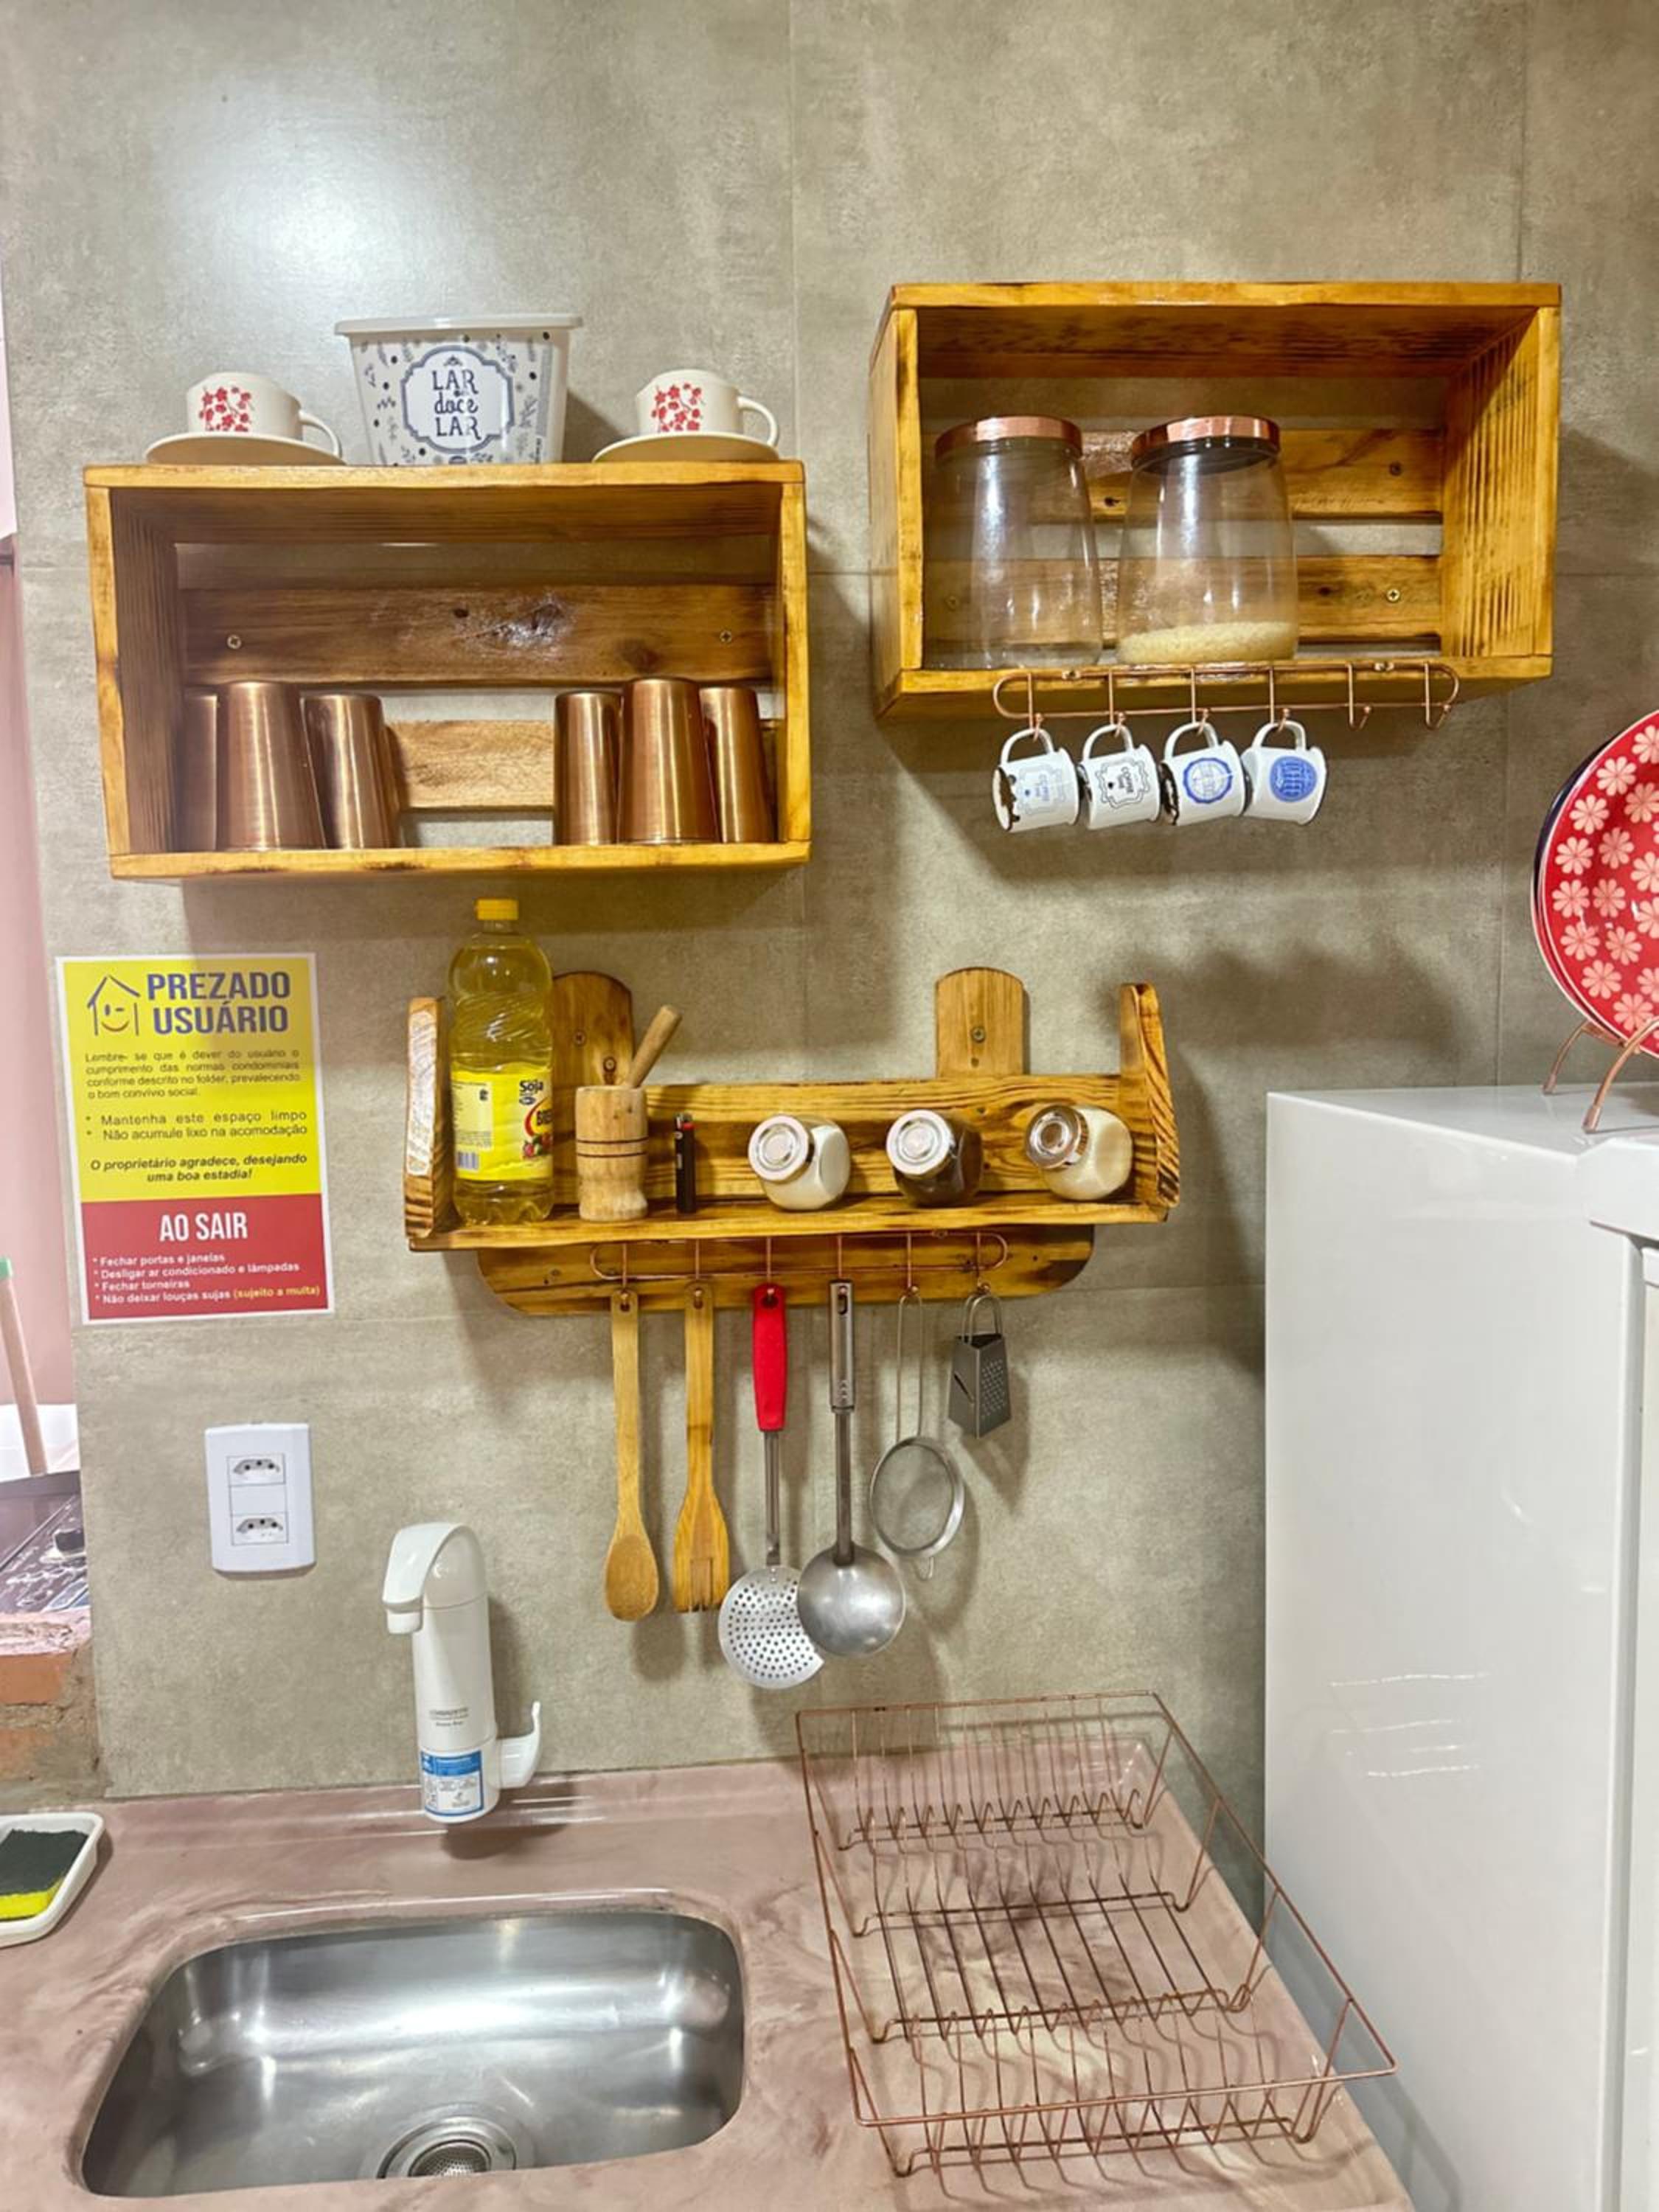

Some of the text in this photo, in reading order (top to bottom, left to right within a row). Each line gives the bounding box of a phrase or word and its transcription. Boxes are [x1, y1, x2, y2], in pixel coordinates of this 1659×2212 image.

[431, 369, 479, 394] LAR
[434, 392, 479, 414] doce
[435, 416, 481, 440] LAR
[147, 971, 291, 1001] PREZADO
[152, 1002, 288, 1034] USUÁRIO
[153, 1051, 174, 1062] que
[192, 1050, 222, 1060] dever
[227, 1049, 241, 1058] do
[86, 1062, 299, 1075] cumprimento das normas condominiais
[87, 1077, 136, 1087] conforme
[137, 1076, 179, 1086] descrito
[181, 1076, 195, 1085] no
[231, 1074, 300, 1084] prevalecendo
[97, 1089, 121, 1099] bom
[101, 1110, 307, 1125] Mantenha este espaço limpo
[102, 1124, 307, 1140] Não acumule lixo na acomodação
[91, 1153, 307, 1172] O proprietário agradece, desejando
[147, 1169, 253, 1183] uma boa estadia!
[159, 1211, 248, 1242] AO SAIR
[100, 1256, 137, 1266] Fechar
[140, 1255, 175, 1267] portas
[186, 1253, 225, 1265] janelas
[101, 1269, 146, 1280] Desligar
[161, 1265, 236, 1276] condicionado
[237, 1265, 246, 1273] e
[247, 1262, 300, 1273] lâmpadas
[102, 1280, 190, 1291] Fechar torneiras
[102, 1294, 125, 1304] Não
[127, 1294, 160, 1303] deixar
[163, 1291, 199, 1302] louças
[201, 1290, 231, 1301] sujas
[234, 1288, 274, 1300] (sujeito
[285, 1286, 321, 1296] multa)
